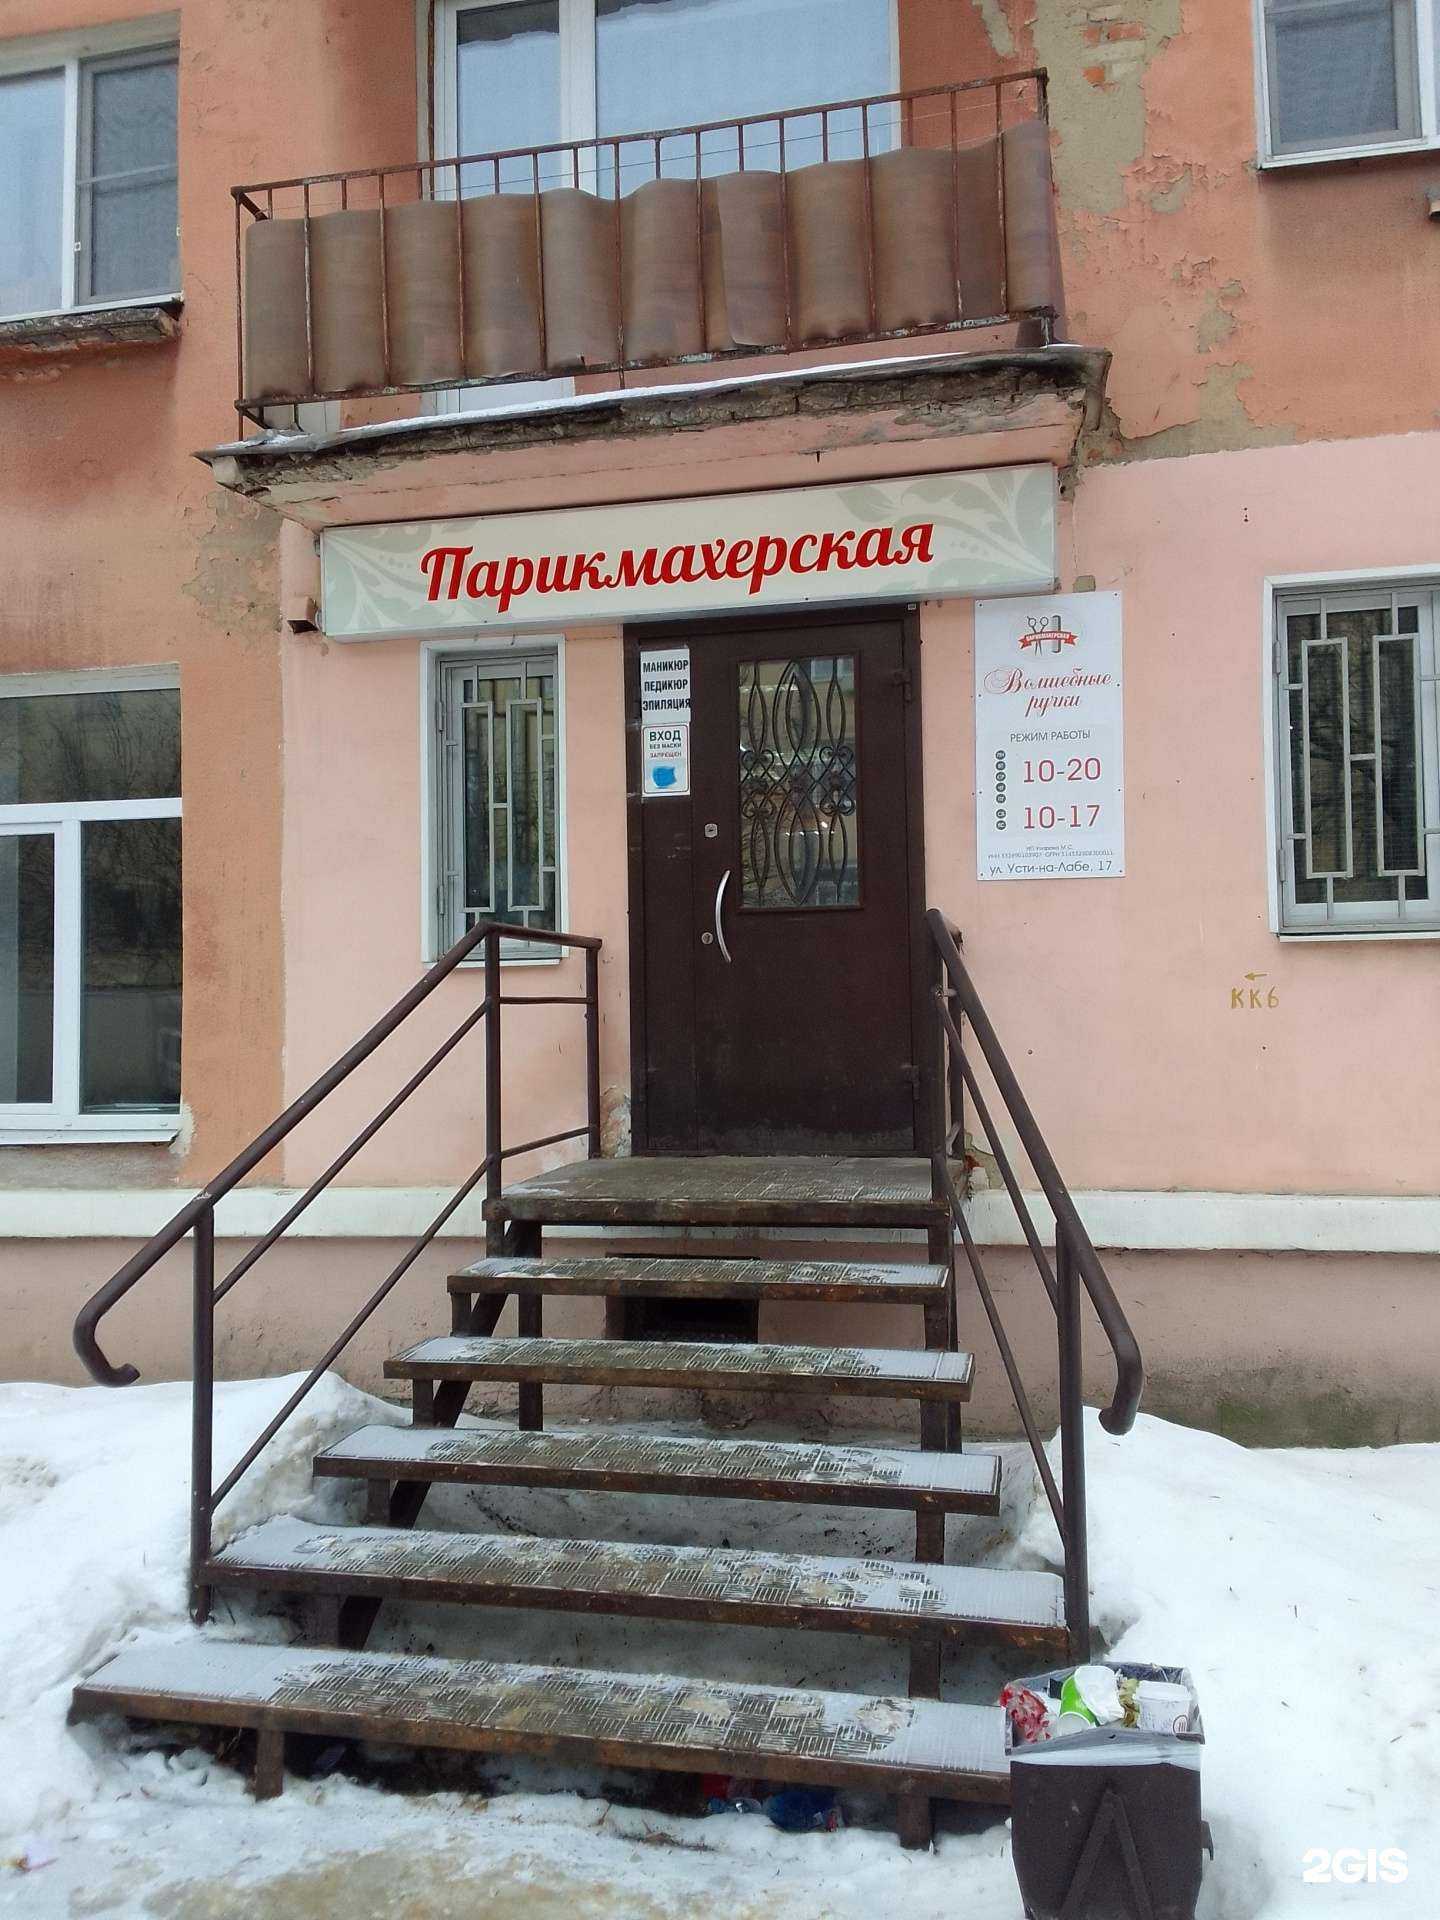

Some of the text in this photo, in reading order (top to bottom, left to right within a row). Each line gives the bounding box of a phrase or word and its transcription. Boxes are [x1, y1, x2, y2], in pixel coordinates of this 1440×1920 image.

[420, 522, 934, 614] Парикмахерская
[642, 659, 689, 673] МАНИКЮР
[644, 679, 688, 693] ПЕДИКЮР
[984, 666, 1112, 695] Волшебные
[642, 698, 691, 712] ЭПИЛЯЦИЯ
[1024, 694, 1081, 718] ручки
[649, 730, 682, 742] ВХОД
[1010, 730, 1091, 742] РЕЖИМ РАБОТЫ
[662, 742, 682, 750] МАСКИ
[650, 751, 682, 759] ЗАПРЕЩЕН
[1023, 757, 1101, 783] 10-20
[1023, 804, 1101, 829] 10-17
[1007, 860, 1094, 873] Усти-на-Лабе,
[1099, 860, 1112, 871] 17
